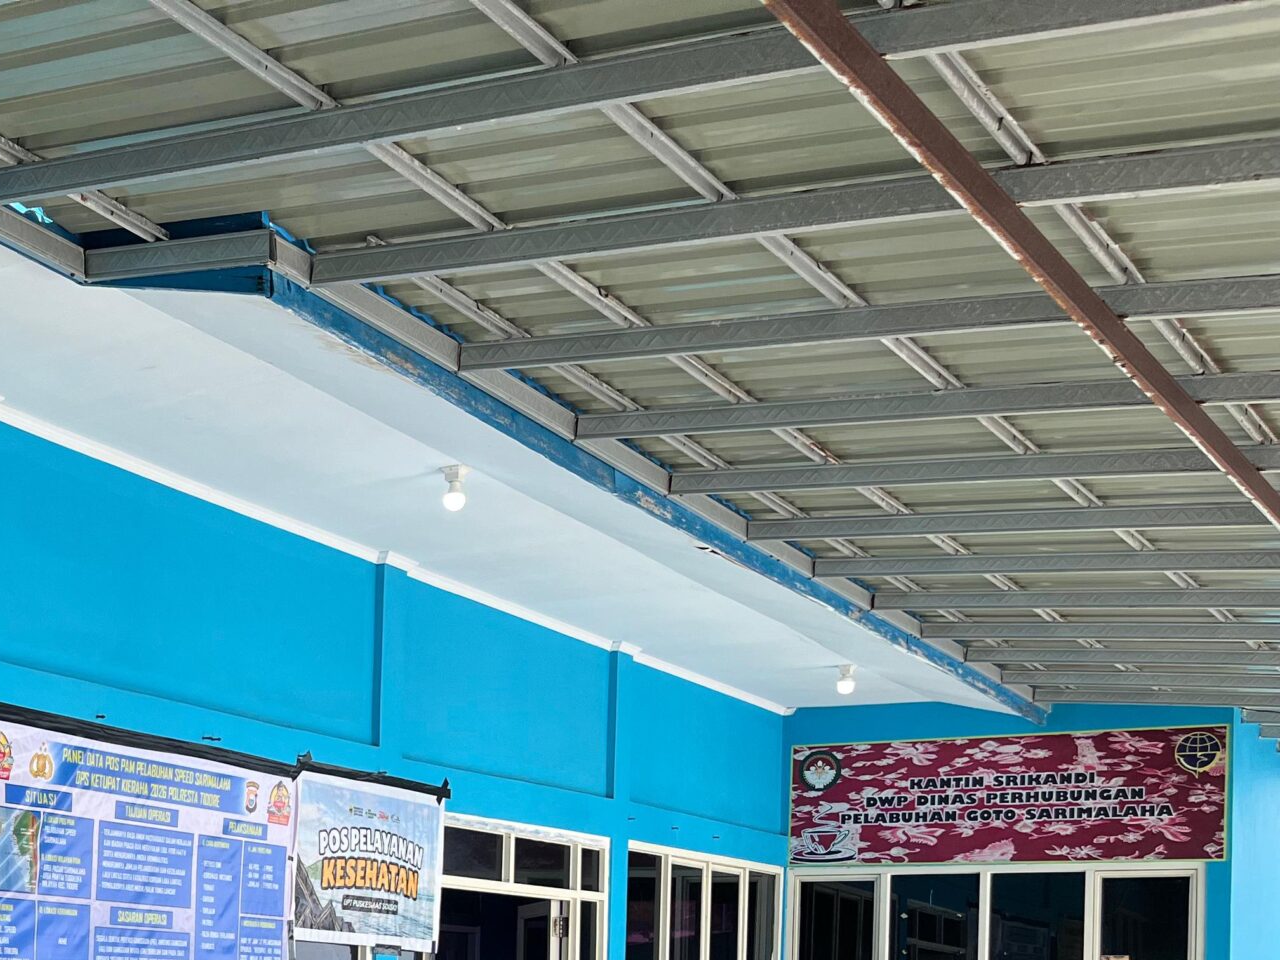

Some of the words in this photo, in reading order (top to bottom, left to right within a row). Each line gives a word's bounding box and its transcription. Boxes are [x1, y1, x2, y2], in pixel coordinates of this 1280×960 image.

[62, 748, 84, 764] PANEL
[86, 752, 103, 767] DATA
[105, 756, 120, 771] POS
[121, 758, 136, 774] PAM
[136, 761, 174, 780] PELABUHAN
[175, 768, 194, 784] SPEED
[91, 774, 121, 790] KETUPAT
[150, 783, 167, 798] 2026
[169, 786, 199, 803] POLRESTA
[909, 776, 984, 790] KANTIN
[992, 772, 1095, 788] SRIKANDI
[25, 789, 57, 806] SITUASI
[865, 795, 909, 808] DWP
[915, 792, 977, 807] DINAS
[985, 788, 1144, 804] PERHUBUNGAN
[125, 804, 147, 820] TUJUAN
[148, 808, 171, 823] OPERASI
[840, 810, 957, 824] PELABUHAN
[966, 808, 1016, 822] GOTO
[1024, 804, 1174, 821] SARIMALAHA
[319, 827, 349, 855] POS
[350, 827, 424, 870] PELAYANAN
[321, 856, 419, 900] KESEHATAN
[117, 910, 144, 923] SASARAN
[144, 912, 168, 925] OPERASI
